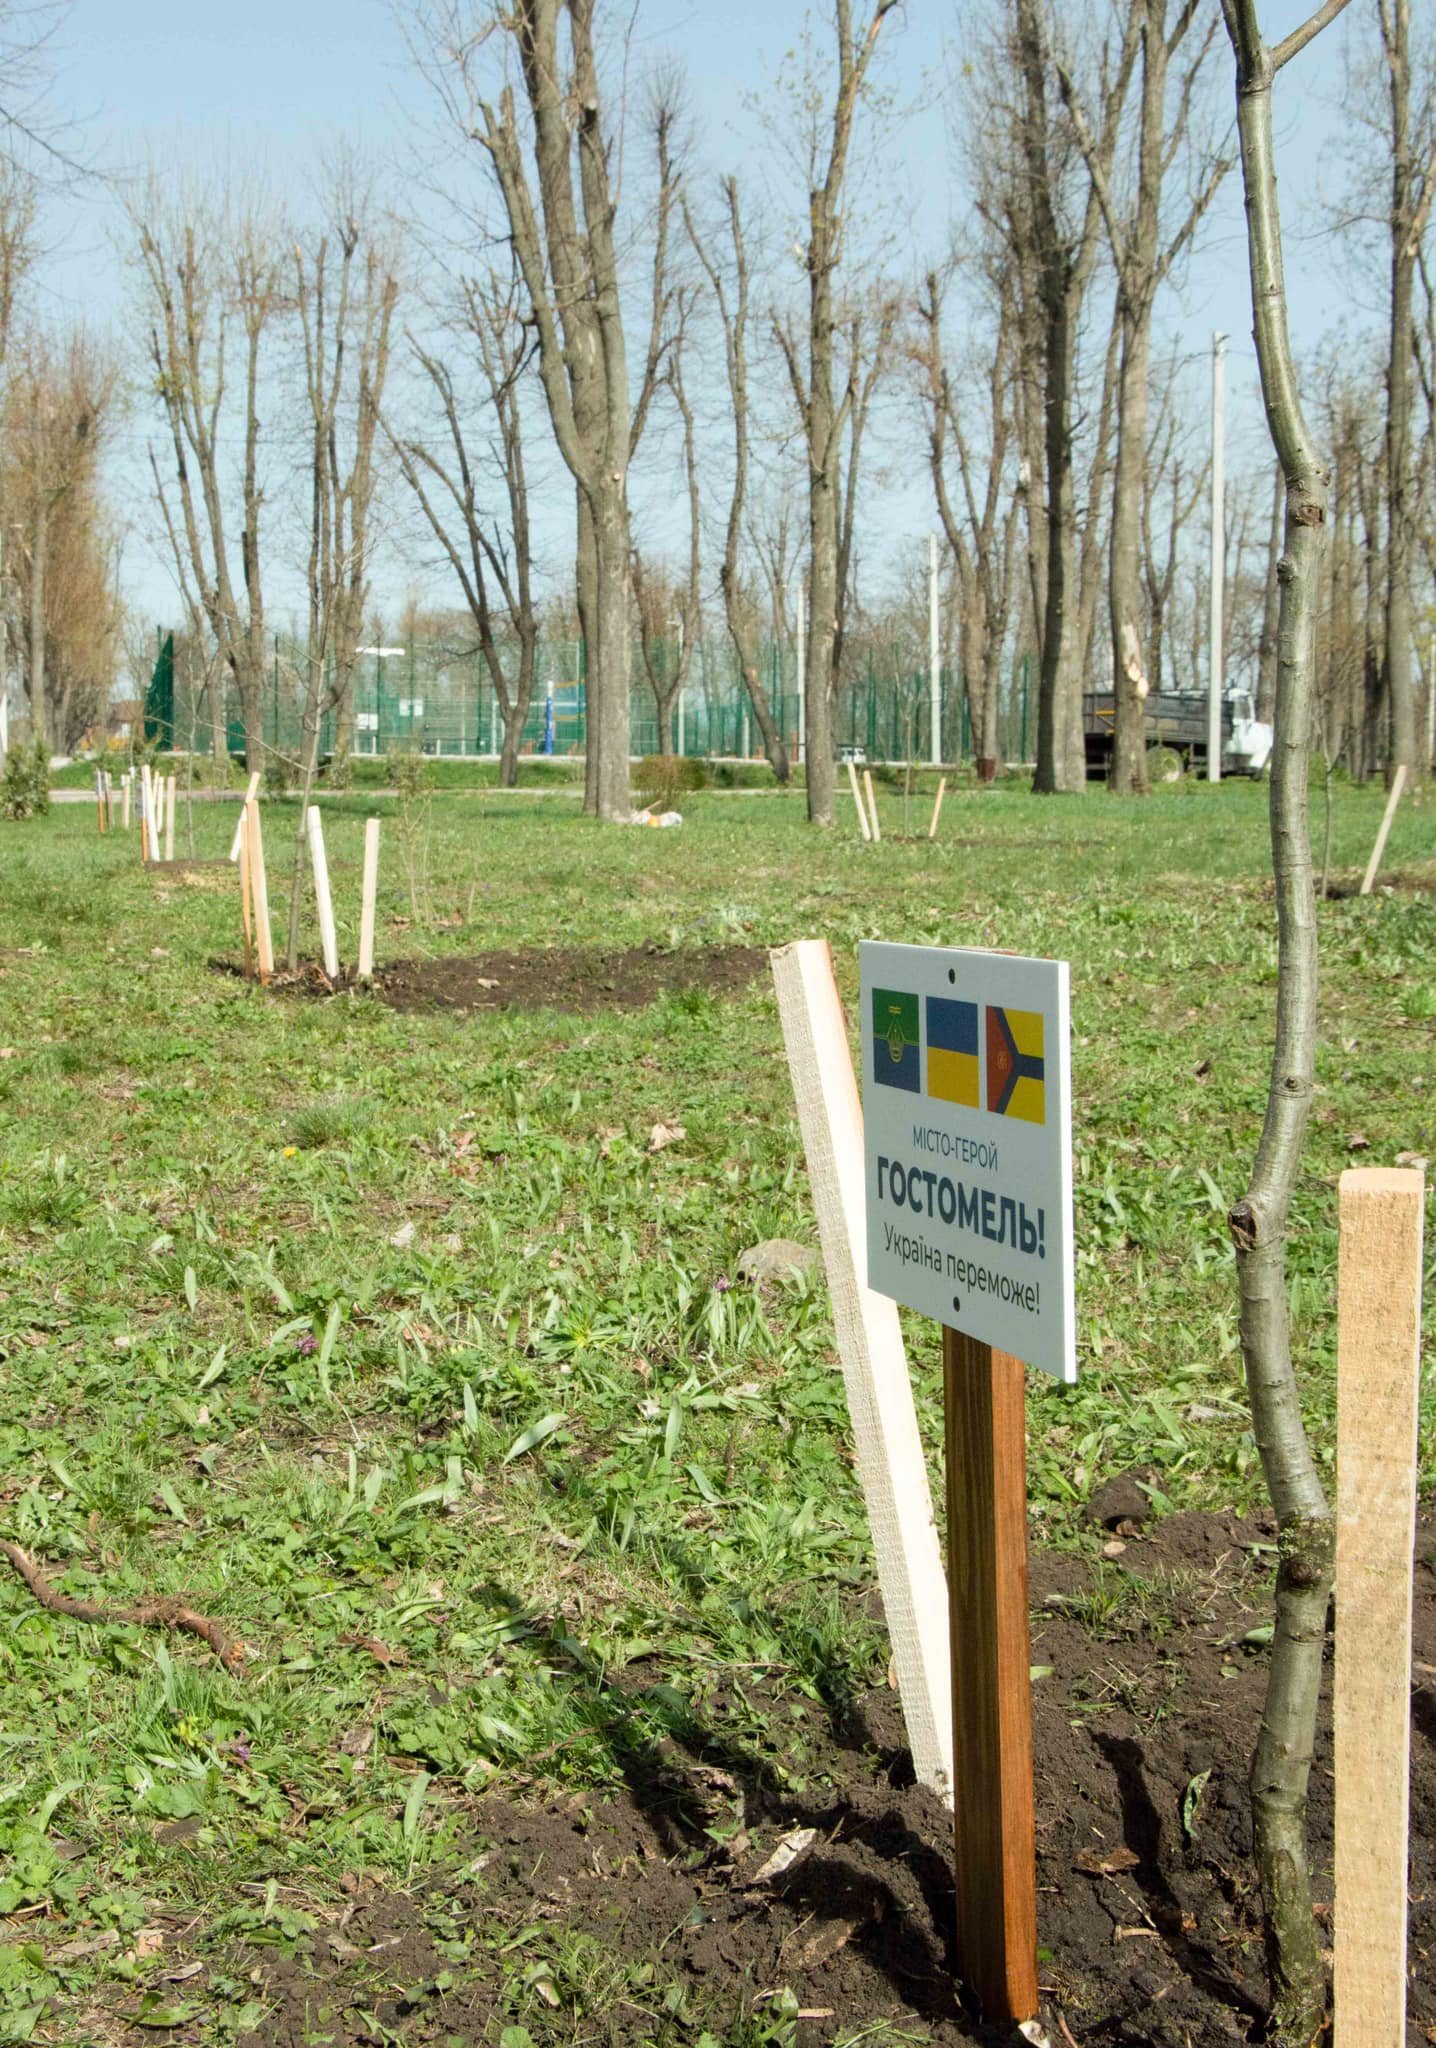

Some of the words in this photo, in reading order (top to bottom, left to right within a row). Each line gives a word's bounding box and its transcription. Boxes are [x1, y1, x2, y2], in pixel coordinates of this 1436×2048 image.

[913, 1125, 998, 1171] МІСТО-ГЕРОЙ
[877, 1155, 1046, 1259] ГОСТОМЕЛЬ!
[884, 1222, 942, 1273] Україна
[946, 1254, 1040, 1315] переможе!
